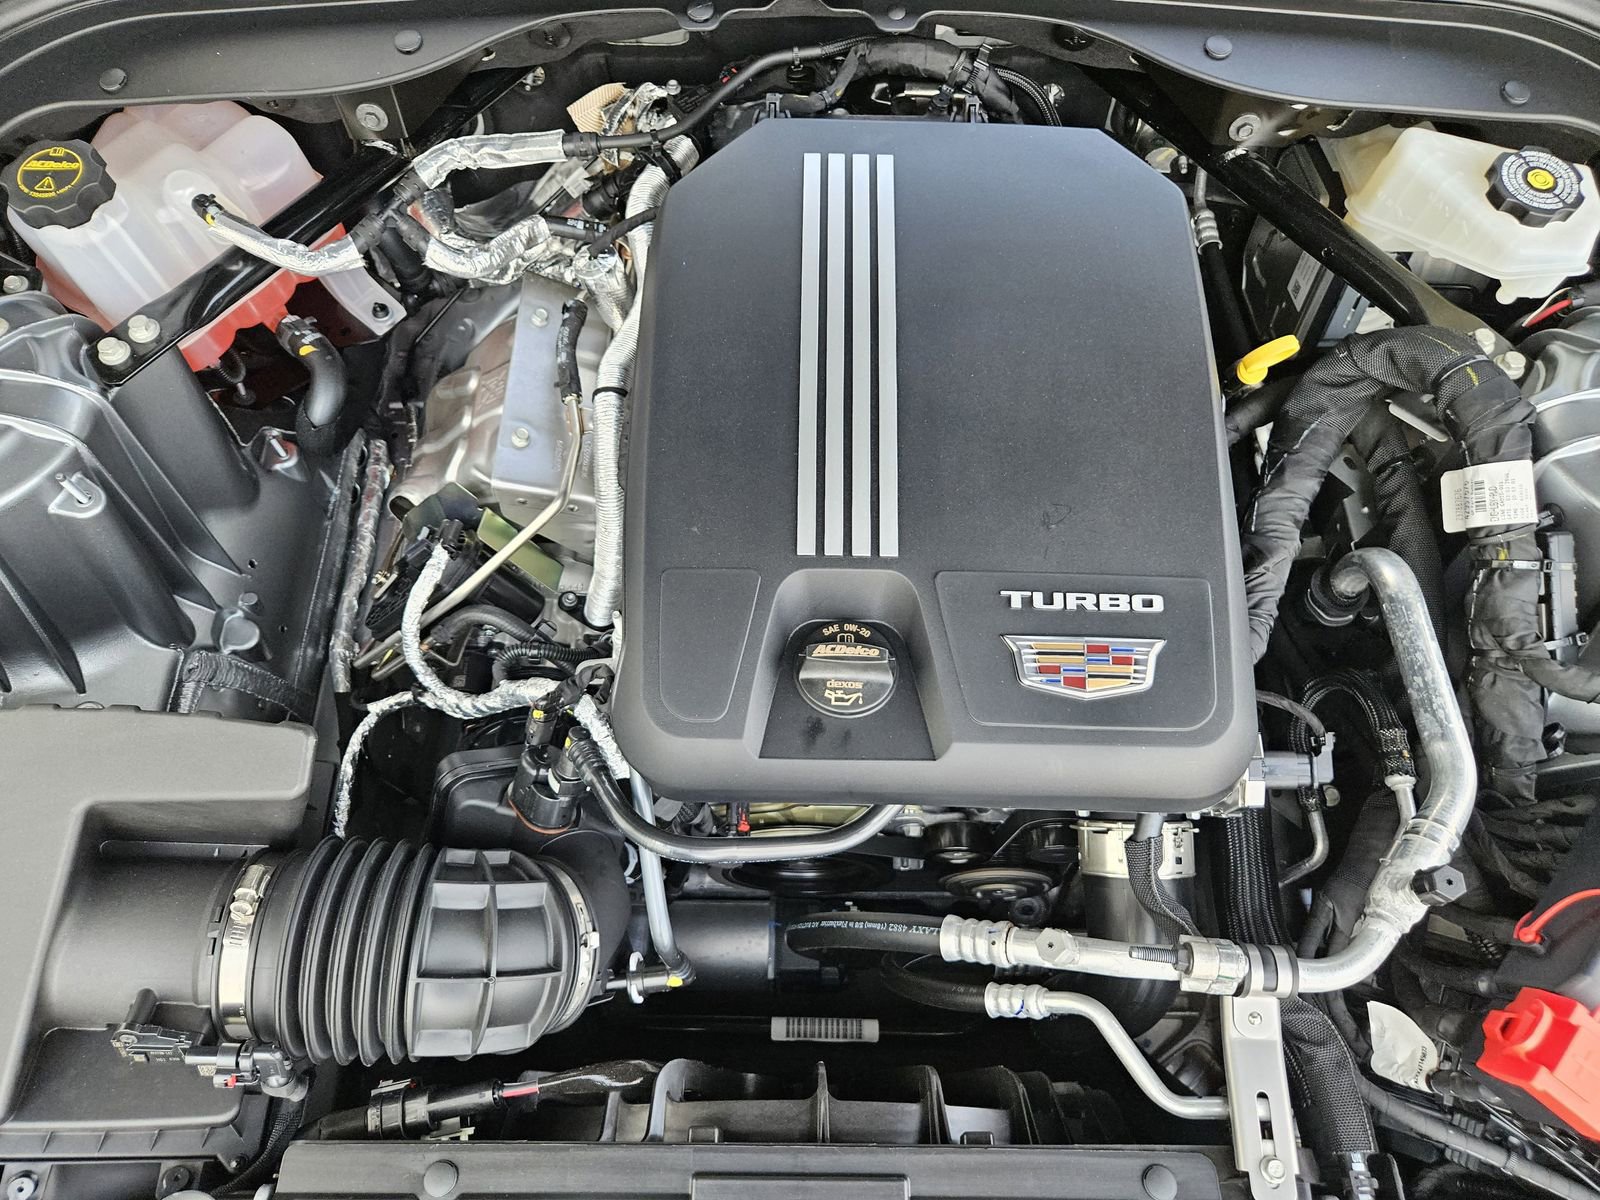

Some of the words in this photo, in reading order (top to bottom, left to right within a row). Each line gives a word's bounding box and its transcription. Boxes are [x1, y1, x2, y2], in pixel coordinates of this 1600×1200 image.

[1000, 589, 1165, 613] TURBO
[822, 623, 840, 636] SAE
[843, 623, 871, 638] 0W-20
[811, 644, 881, 658] ACDelco
[826, 679, 864, 689] dexos
[908, 924, 941, 936] LAXY
